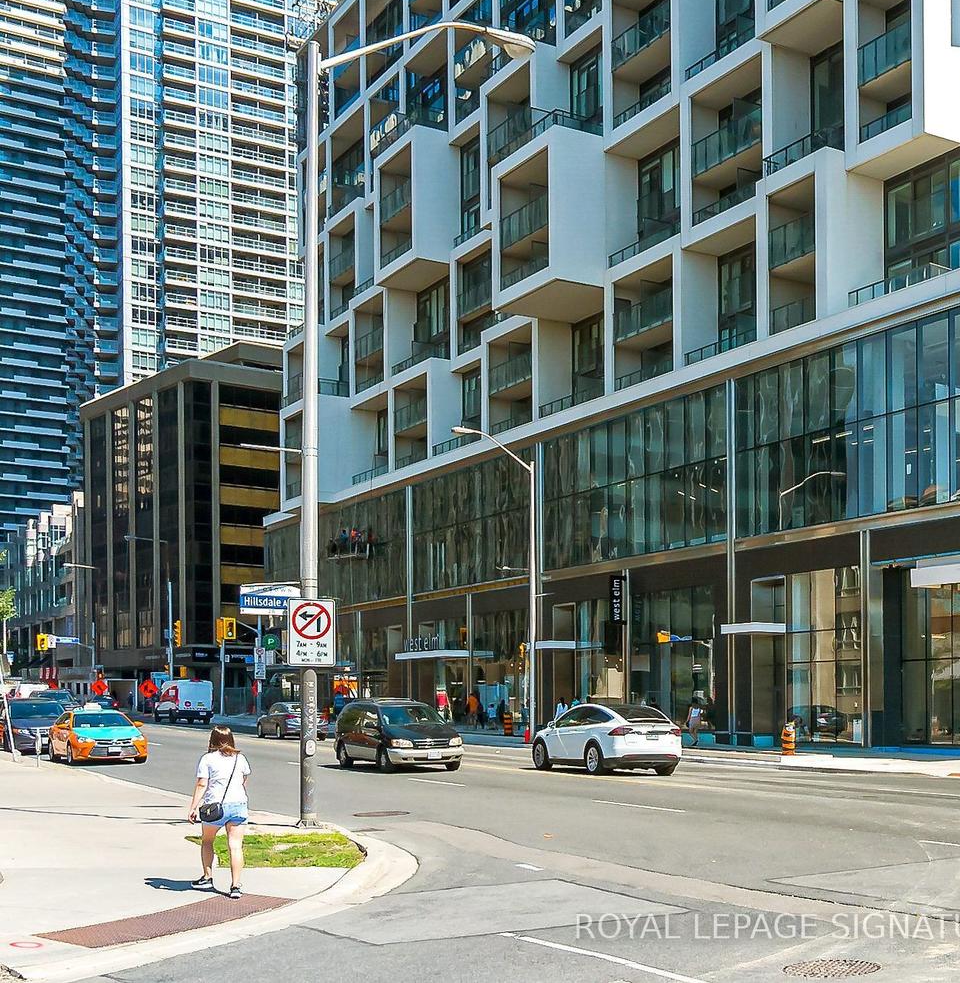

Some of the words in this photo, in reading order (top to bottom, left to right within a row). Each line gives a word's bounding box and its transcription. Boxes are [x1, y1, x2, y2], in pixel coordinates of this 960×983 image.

[612, 579, 620, 596] elm
[243, 596, 281, 607] Hillsdale
[612, 599, 620, 621] west
[403, 634, 422, 652] west
[423, 632, 440, 651] elm
